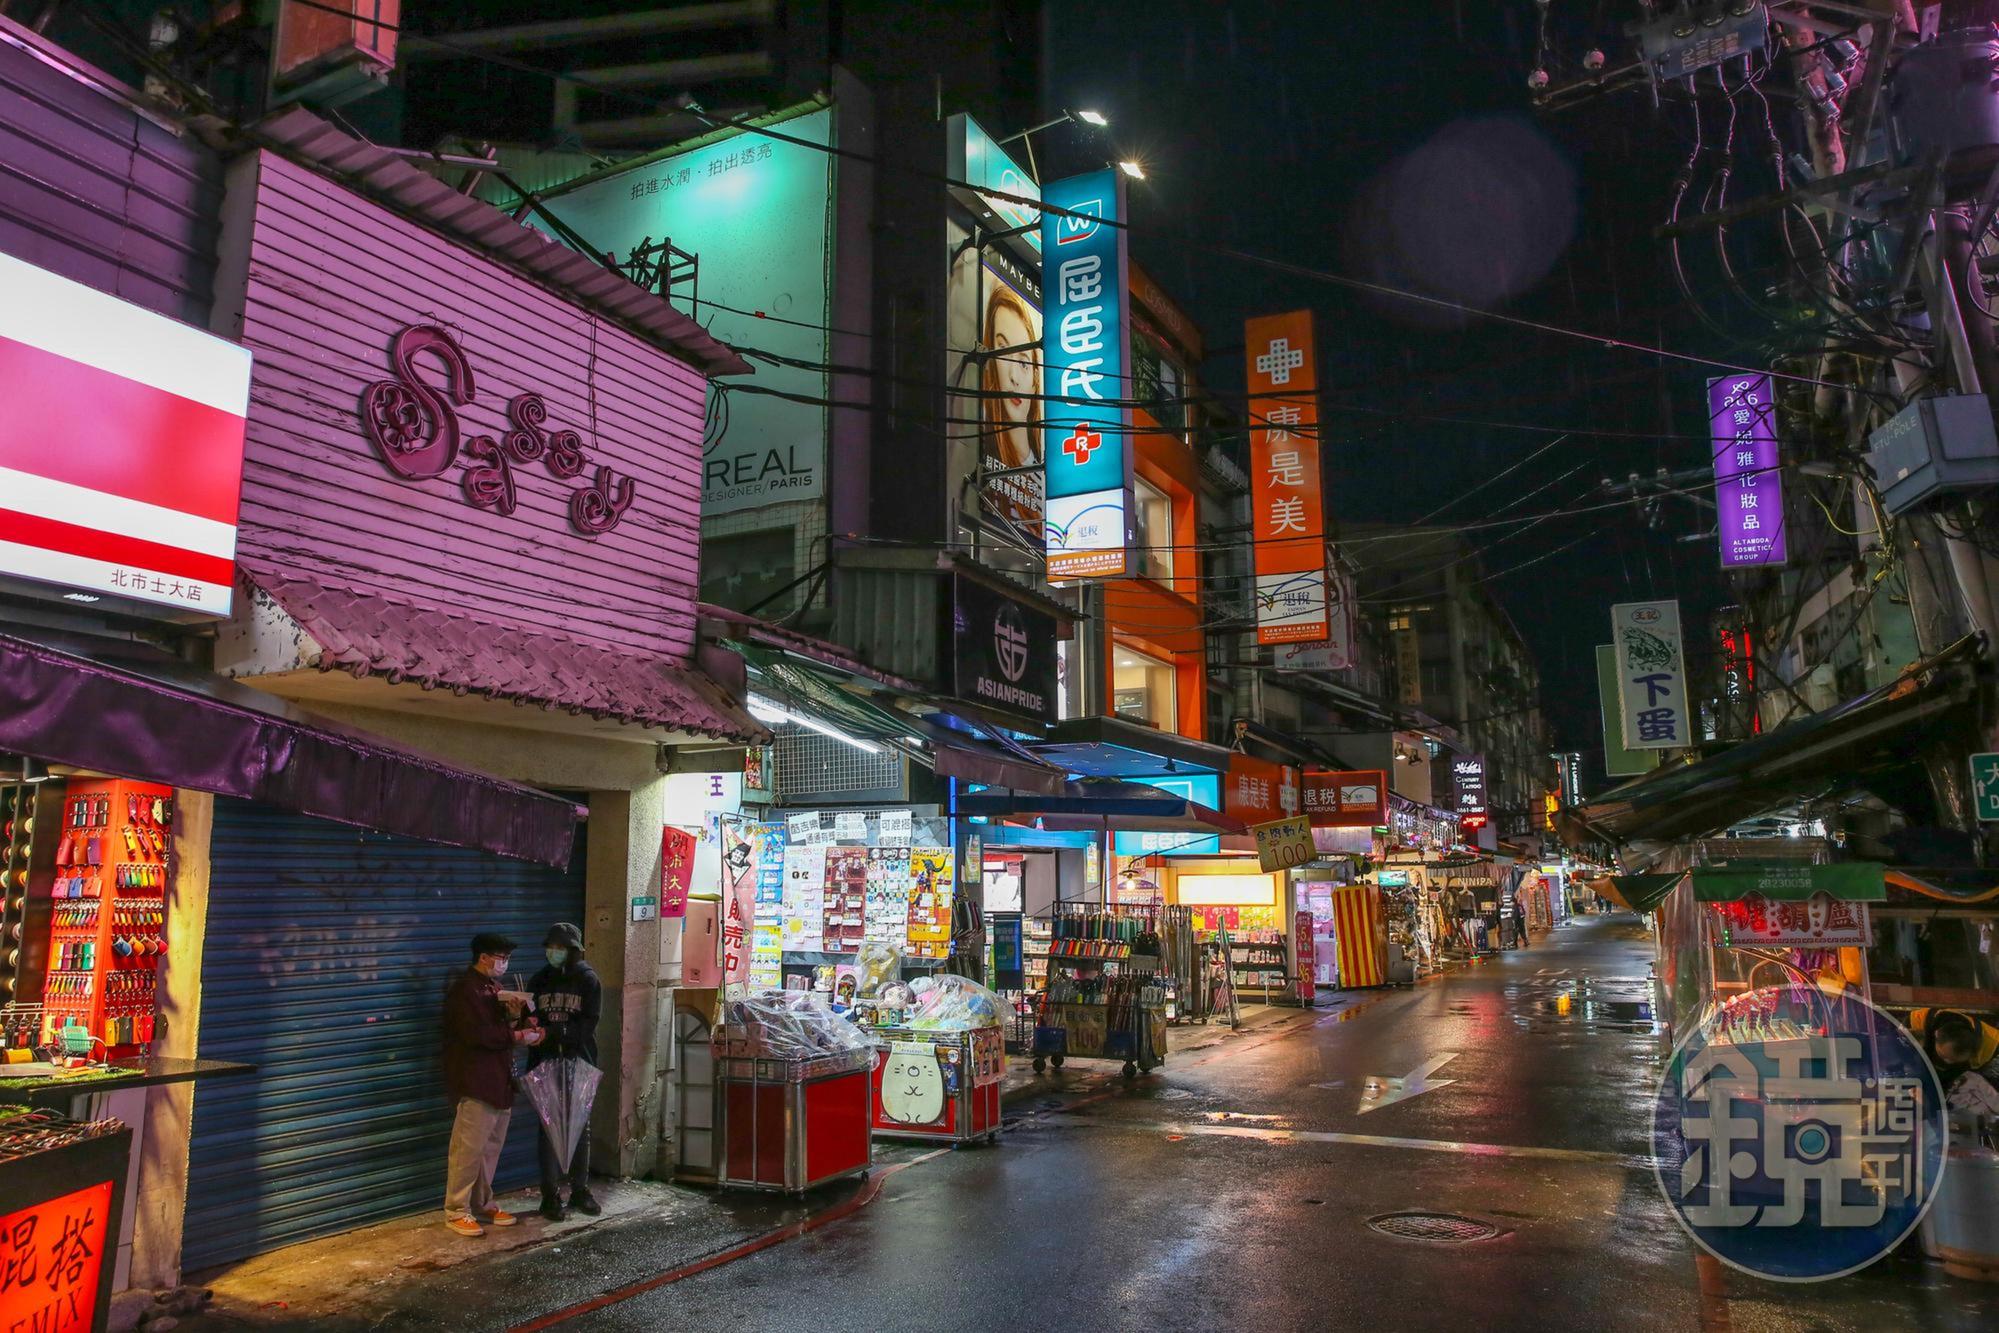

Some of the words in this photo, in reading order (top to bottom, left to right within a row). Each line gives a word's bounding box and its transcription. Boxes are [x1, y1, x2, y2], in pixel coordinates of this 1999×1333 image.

[1060, 254, 1104, 407] 屈臣氏
[1265, 404, 1307, 536] 康是美
[111, 569, 203, 601] 北市士大店
[977, 676, 1043, 711] ASIANPRIDE
[1632, 673, 1677, 742] 下蛋
[1238, 774, 1270, 810] 康是美
[1270, 842, 1308, 867] 100
[641, 907, 648, 918] 9
